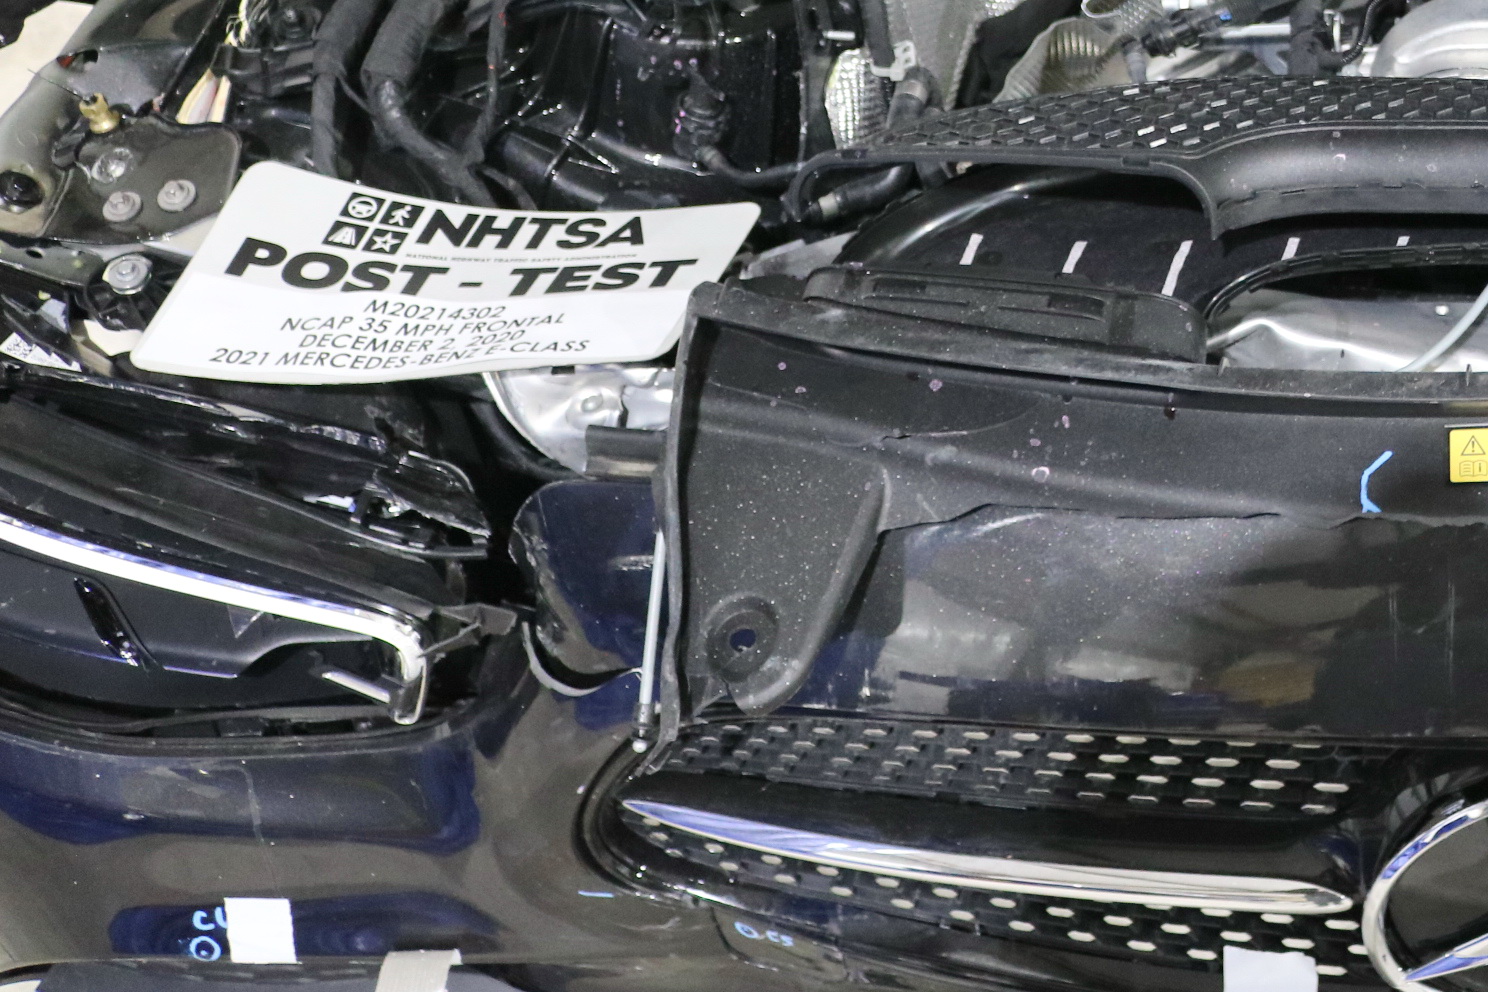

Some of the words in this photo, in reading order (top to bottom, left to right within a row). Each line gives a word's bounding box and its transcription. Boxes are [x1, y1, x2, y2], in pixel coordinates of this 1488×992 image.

[415, 209, 644, 250] NHTSA
[224, 237, 451, 296] POST
[508, 258, 699, 297] TEST
[363, 299, 506, 321] M20214302
[280, 316, 354, 331] NCAP
[358, 317, 391, 334] 35
[395, 322, 454, 337] MPH
[458, 313, 565, 335] FRONTAL
[298, 334, 433, 353] DECEMBER
[466, 329, 526, 347] 2020
[209, 348, 270, 366] 2021
[275, 348, 481, 370] MERCEDES-BENZ
[484, 340, 590, 356] E-CLASS
